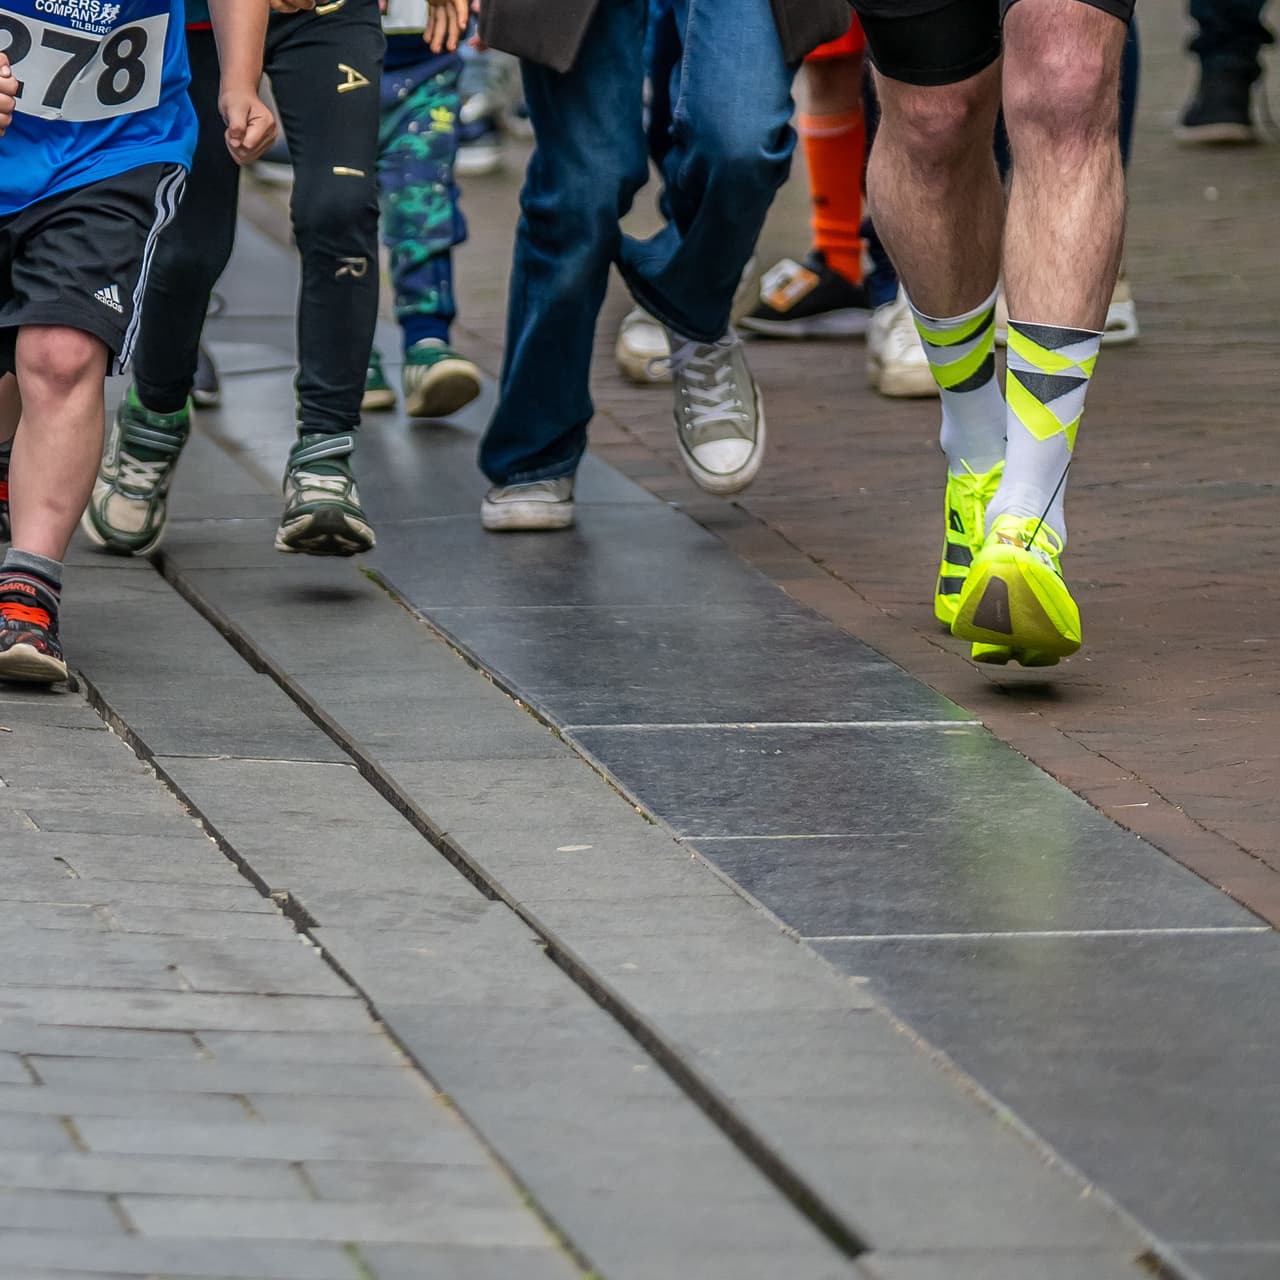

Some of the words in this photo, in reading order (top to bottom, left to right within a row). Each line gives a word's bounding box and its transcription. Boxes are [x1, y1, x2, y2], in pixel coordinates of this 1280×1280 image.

[35, 0, 99, 23] COMPANY
[70, 19, 113, 34] TILBURG
[93, 292, 125, 314] adidas
